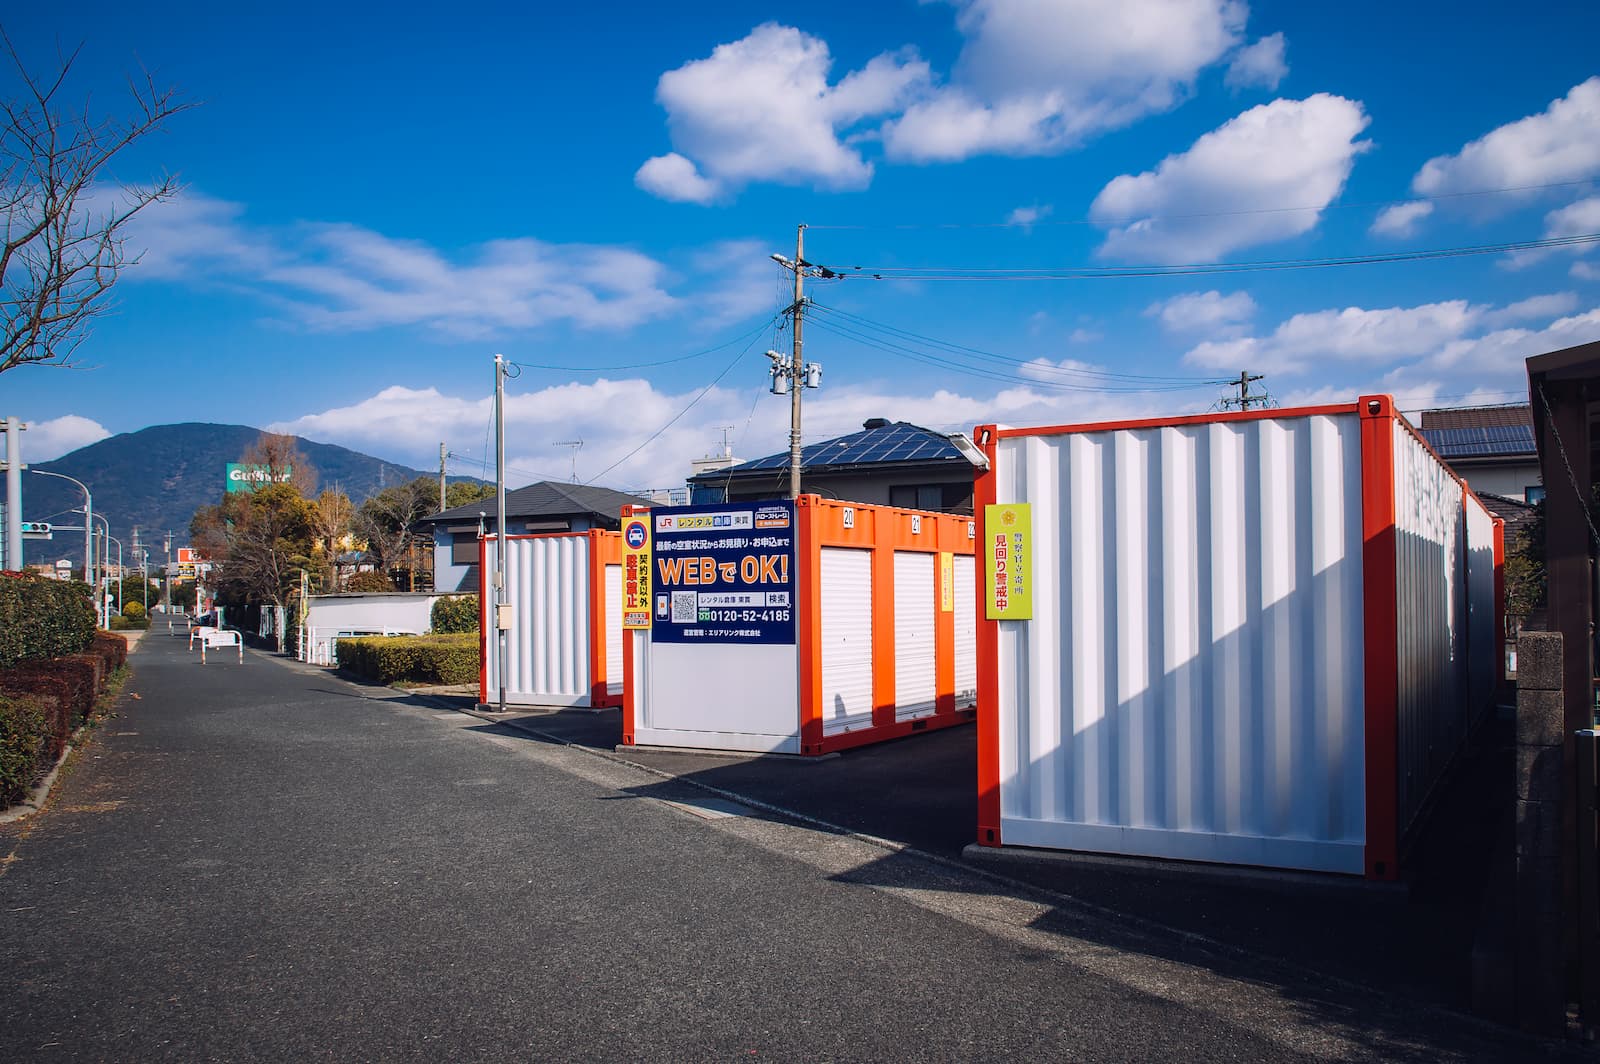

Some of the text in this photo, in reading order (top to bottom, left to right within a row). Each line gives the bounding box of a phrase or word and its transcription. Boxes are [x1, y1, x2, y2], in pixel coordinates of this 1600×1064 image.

[660, 518, 672, 527] JR
[844, 510, 853, 525] 20
[913, 517, 920, 531] 21
[640, 554, 648, 607] 契約者以外
[995, 534, 1008, 611] 見回り警戒中
[1014, 532, 1023, 595] 警察官立寄所
[626, 554, 638, 608] 駐車禁止
[711, 610, 790, 621] 0120-52-4185
